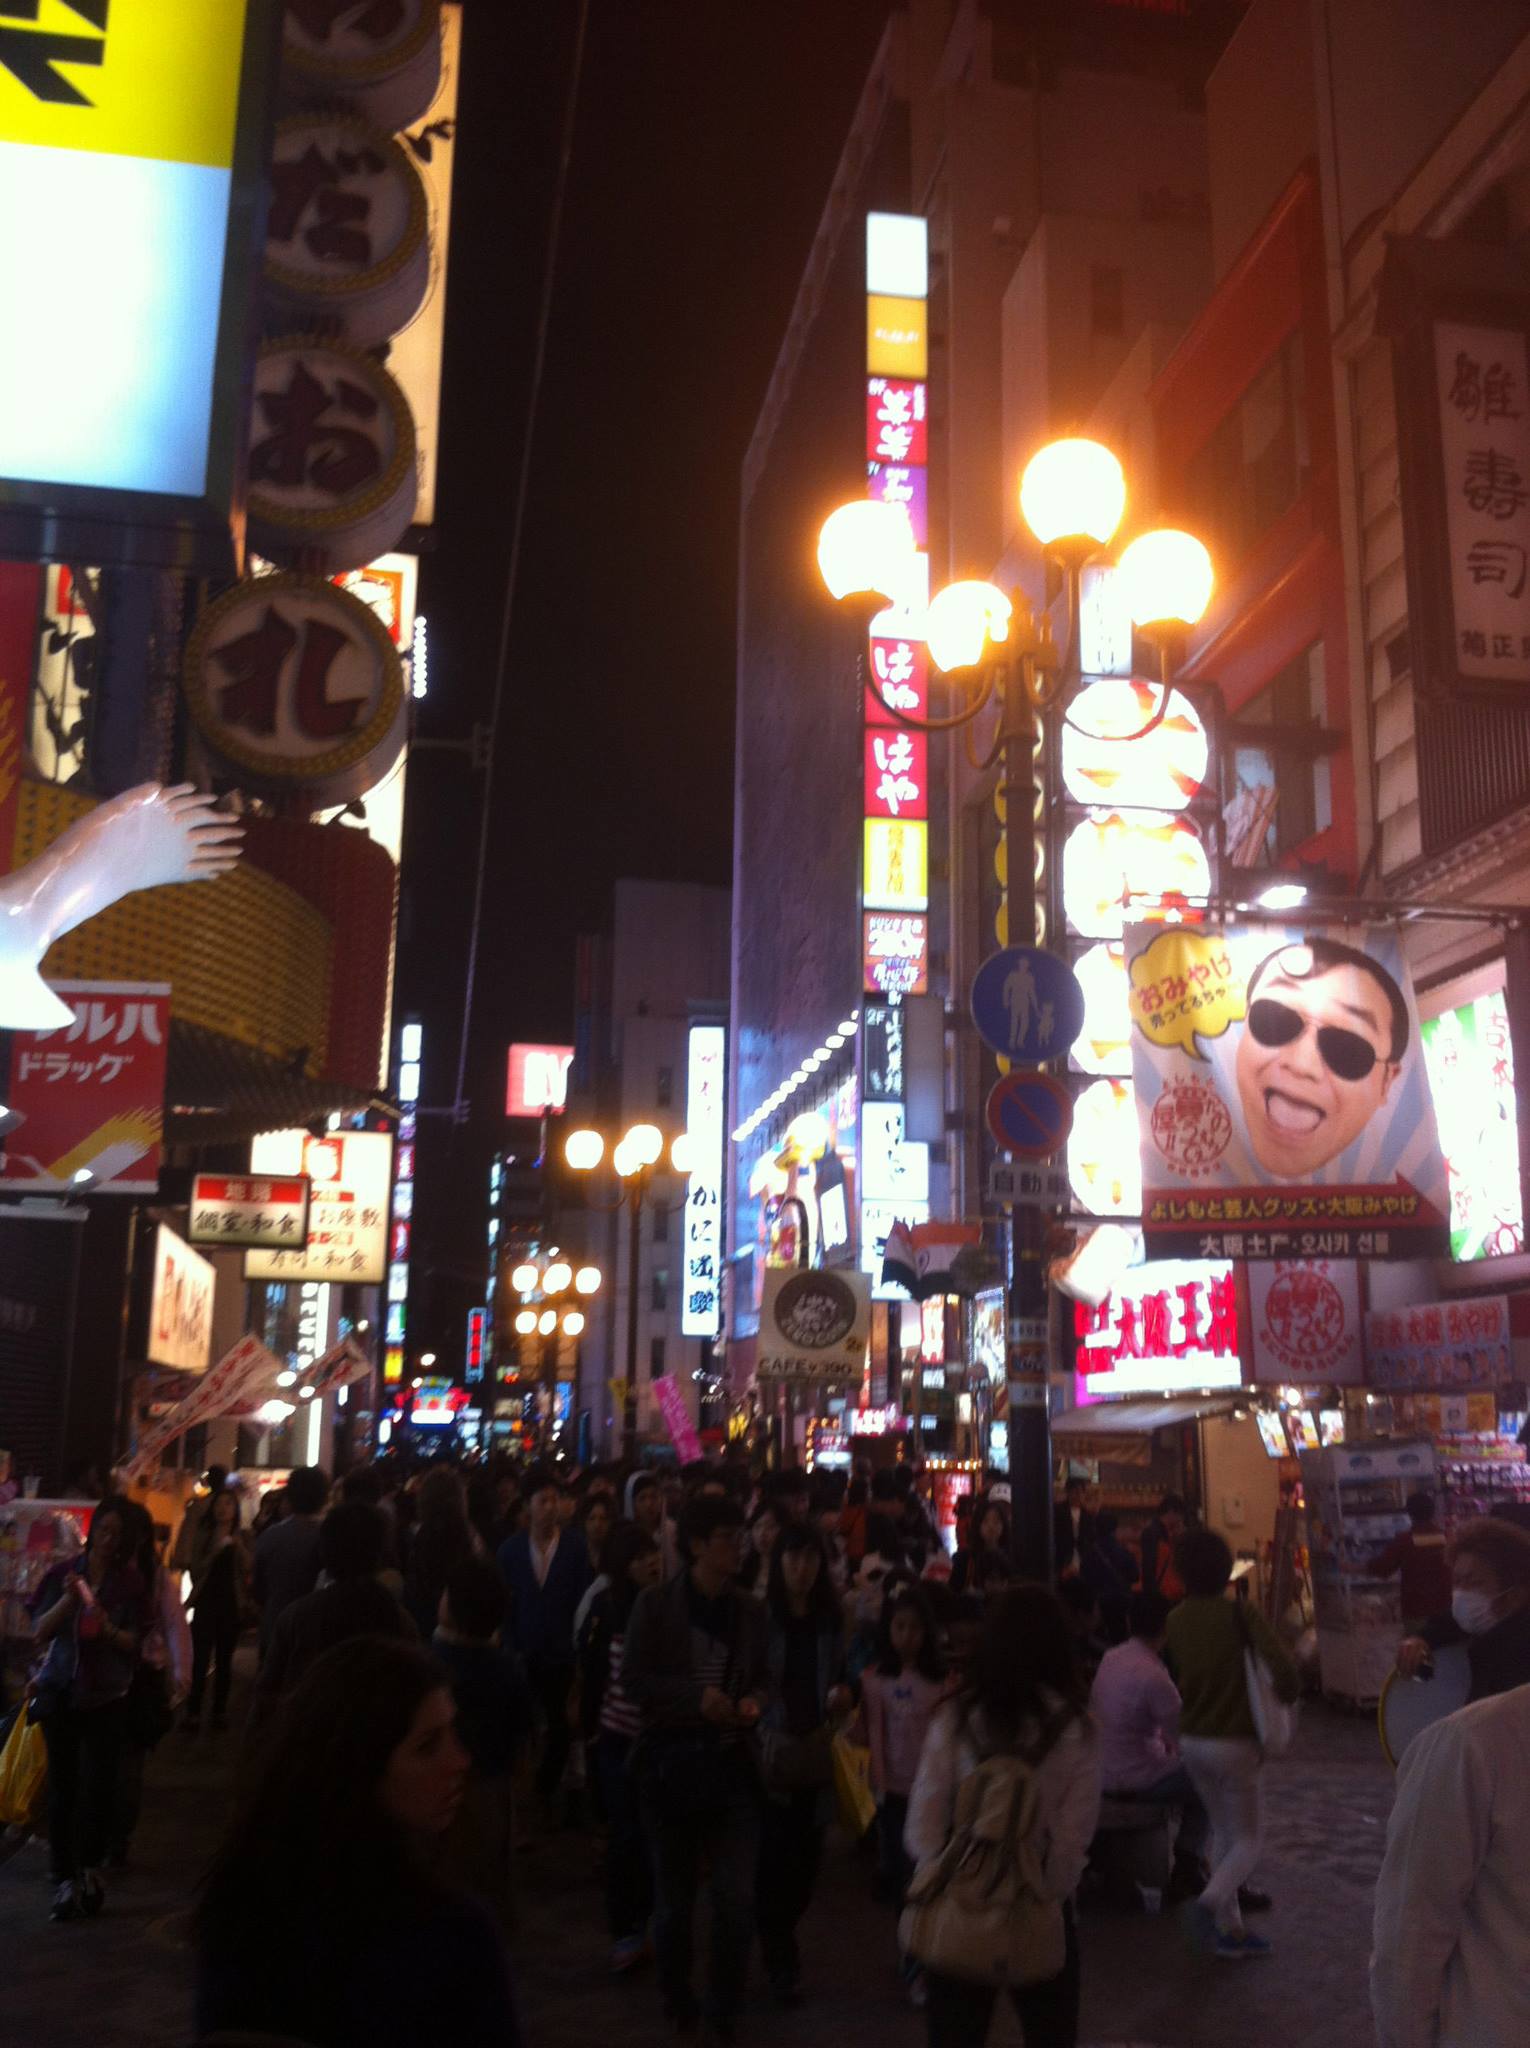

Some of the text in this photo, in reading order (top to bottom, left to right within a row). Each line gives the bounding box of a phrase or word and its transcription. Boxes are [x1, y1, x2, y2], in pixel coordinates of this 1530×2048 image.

[35, 1003, 162, 1045] ルハ
[19, 1050, 135, 1084] ドラッグ
